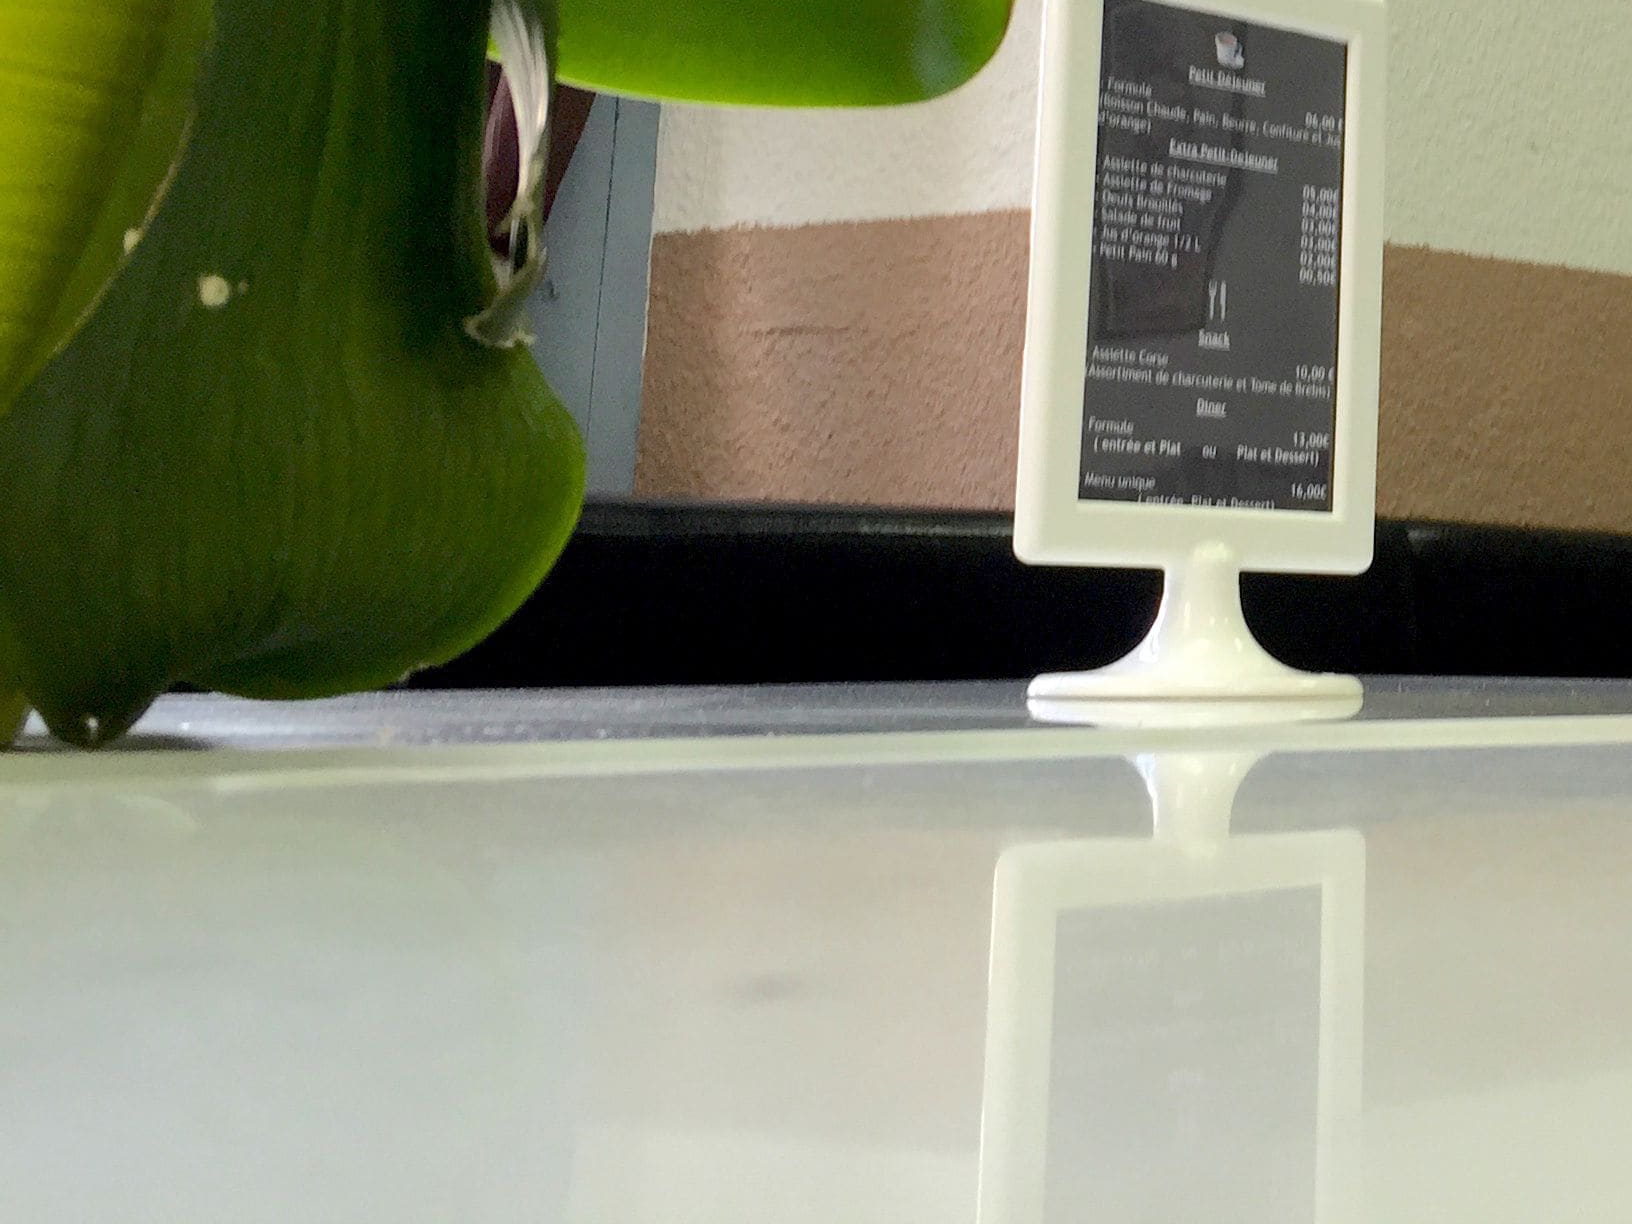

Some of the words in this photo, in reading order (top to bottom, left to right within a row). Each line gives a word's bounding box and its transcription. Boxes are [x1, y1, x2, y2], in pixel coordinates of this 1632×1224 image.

[1107, 76, 1152, 98] Formule
[1296, 363, 1326, 383] 10,00
[1087, 415, 1135, 436] Formule
[1144, 439, 1156, 456] et
[1159, 438, 1181, 457] Plat
[1202, 444, 1217, 459] ou
[1237, 444, 1258, 461] Plat
[1260, 446, 1272, 463] et
[1293, 431, 1330, 450] 13,00€
[1084, 471, 1115, 488] Menu
[1117, 475, 1156, 493] unique
[1291, 482, 1327, 501] 16,00€
